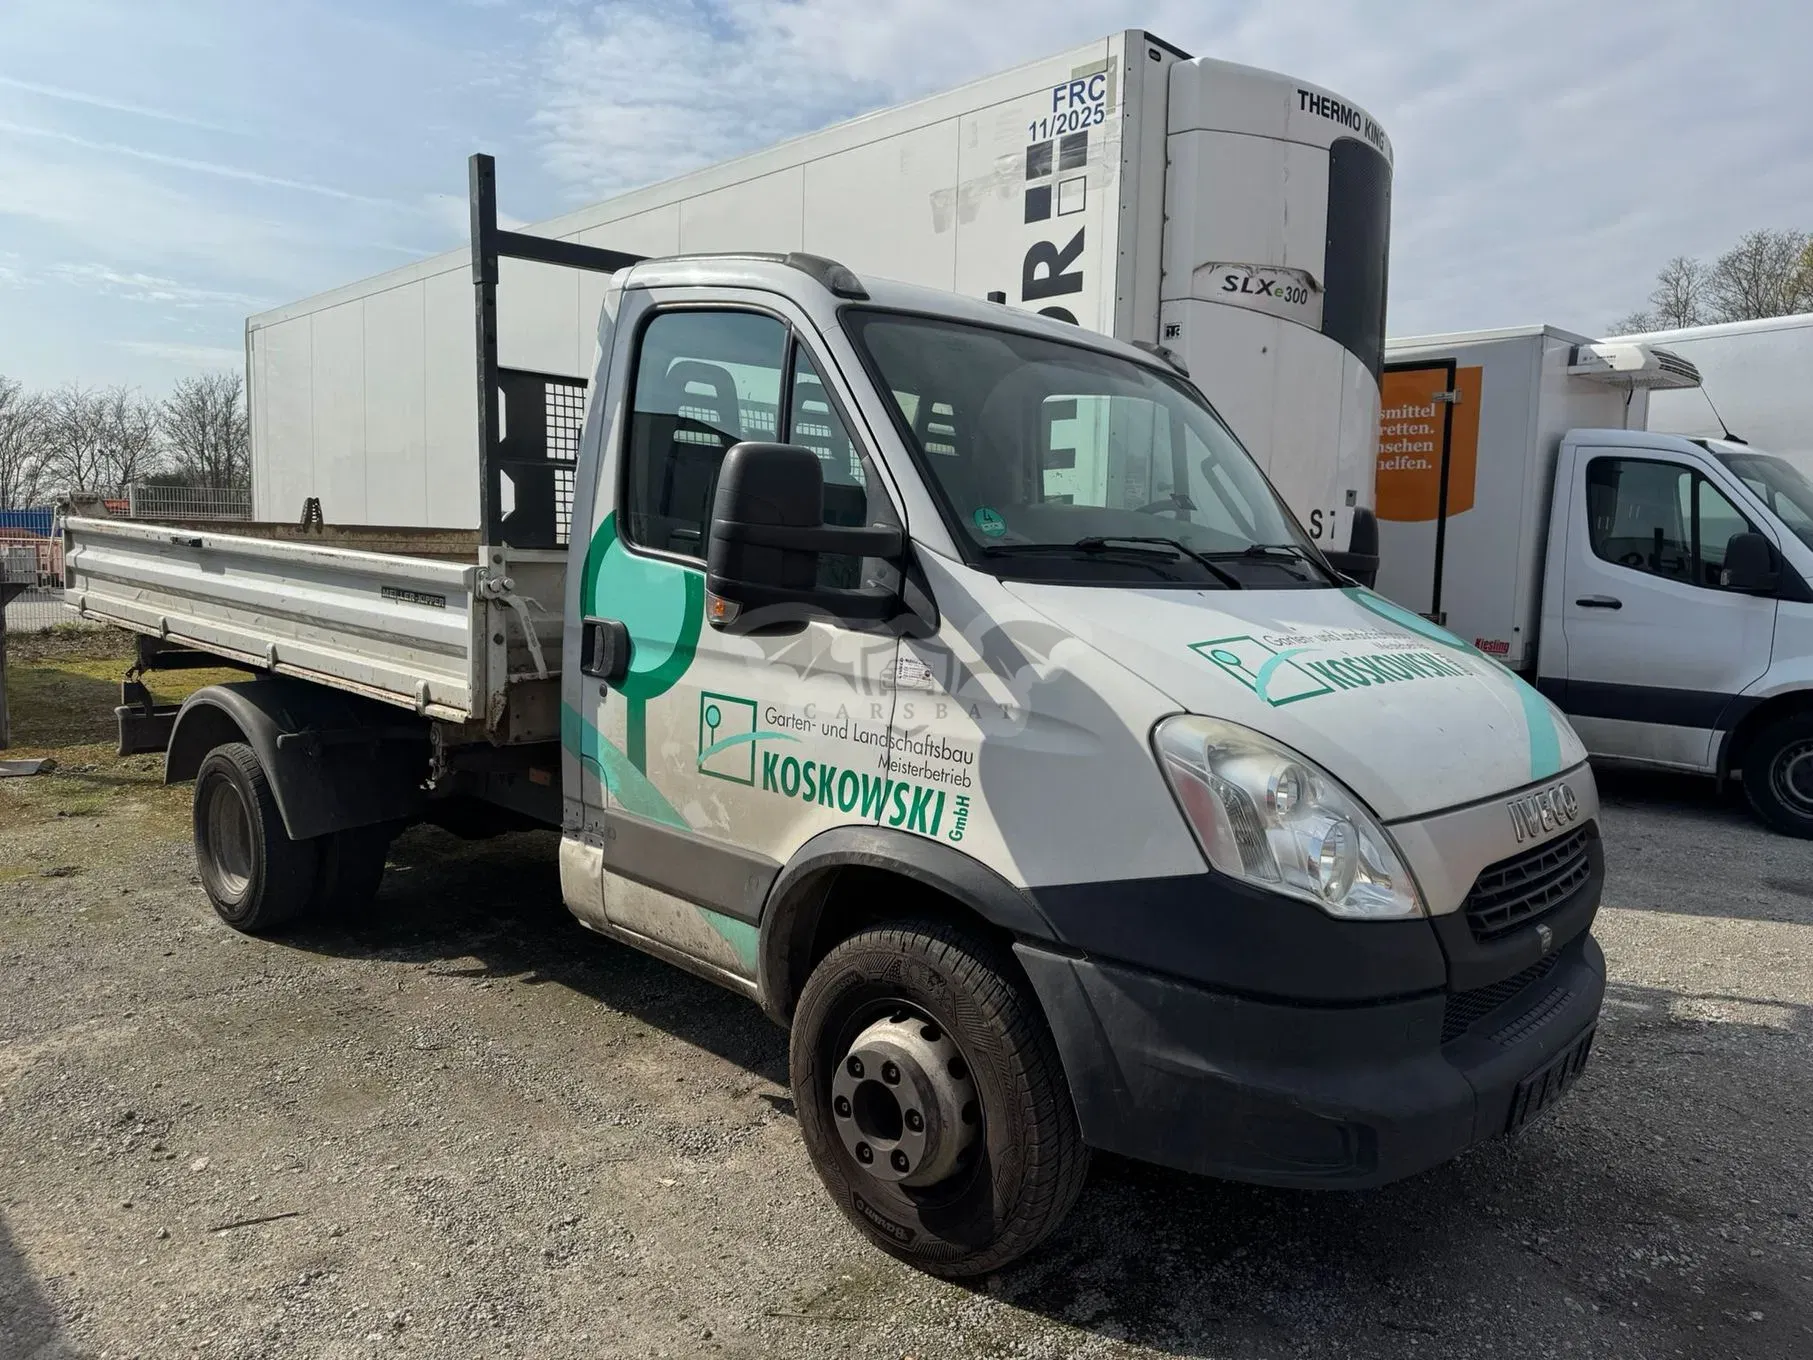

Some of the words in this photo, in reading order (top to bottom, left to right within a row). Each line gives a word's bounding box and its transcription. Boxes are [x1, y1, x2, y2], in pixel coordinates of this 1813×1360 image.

[1052, 74, 1107, 113] FRC
[1028, 102, 1106, 142] 11/2025
[1297, 88, 1362, 132] THERMO
[1364, 117, 1385, 153] KING
[1305, 652, 1464, 690] KOSKOWSKI
[764, 706, 817, 733] Garten-
[821, 717, 849, 741] und
[853, 722, 974, 766] Landschaftsbau
[762, 751, 947, 837] KOSKOWSKI
[877, 755, 972, 789] Meisterbetrieb
[948, 795, 971, 842] GmbH
[1506, 782, 1579, 843] IVECO
